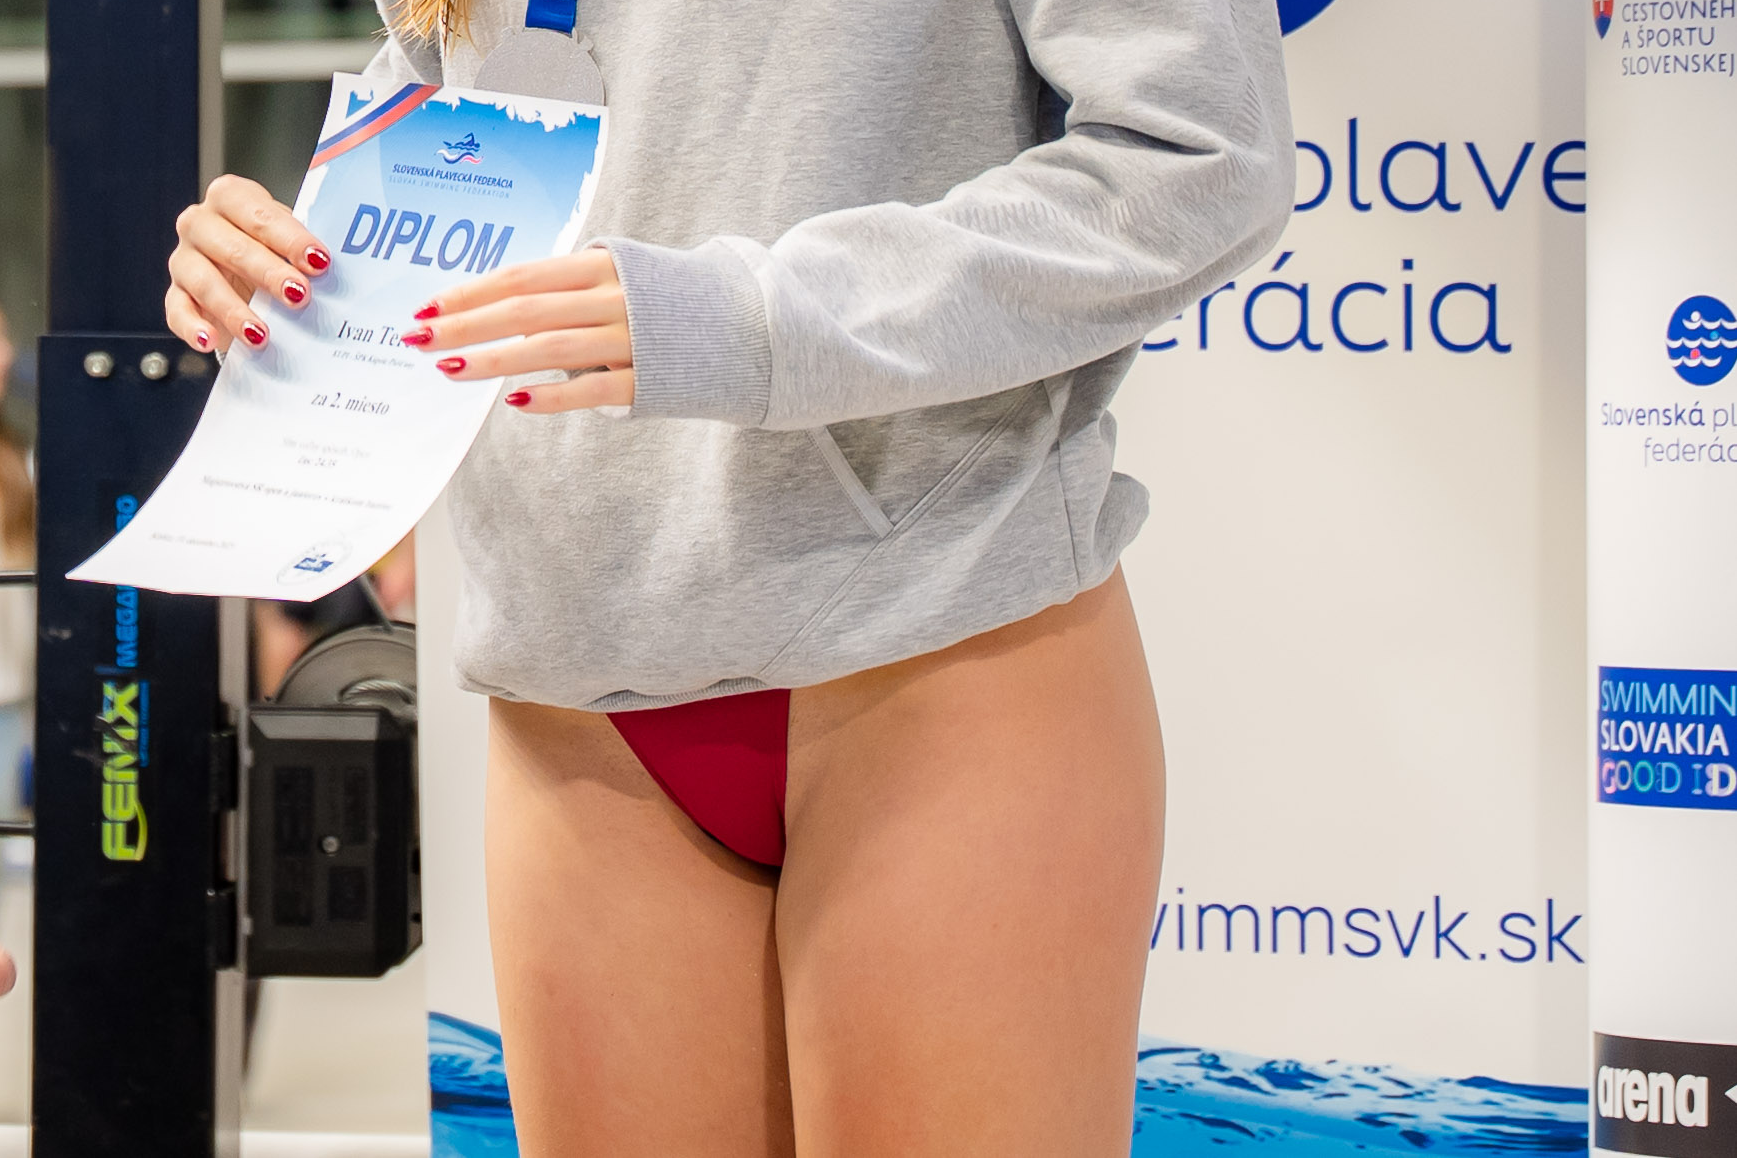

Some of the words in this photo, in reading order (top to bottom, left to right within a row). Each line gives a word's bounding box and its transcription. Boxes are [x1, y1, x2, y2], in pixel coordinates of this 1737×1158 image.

[1622, 30, 1631, 49] A
[1637, 25, 1715, 48] ŠPORTU
[1621, 53, 1735, 77] SLOVENSKEJ
[391, 163, 435, 178] SLOVENSKÁ
[435, 168, 474, 184] PLAVECKÁ
[473, 173, 514, 189] FEDERÁCIA
[341, 203, 515, 274] DIPLOM
[337, 319, 375, 343] Ivan
[311, 393, 328, 407] za
[329, 391, 341, 410] 2.
[345, 395, 390, 416] miesto
[1601, 401, 1705, 427] Slovenská
[1644, 436, 1737, 467] federác
[1601, 679, 1737, 717] SWIMMIN
[1601, 718, 1730, 756] SLOVAKIA
[102, 680, 143, 861] FENIX
[1602, 759, 1682, 794] GOOD
[1691, 762, 1737, 797] ID
[1598, 1065, 1709, 1128] arena
